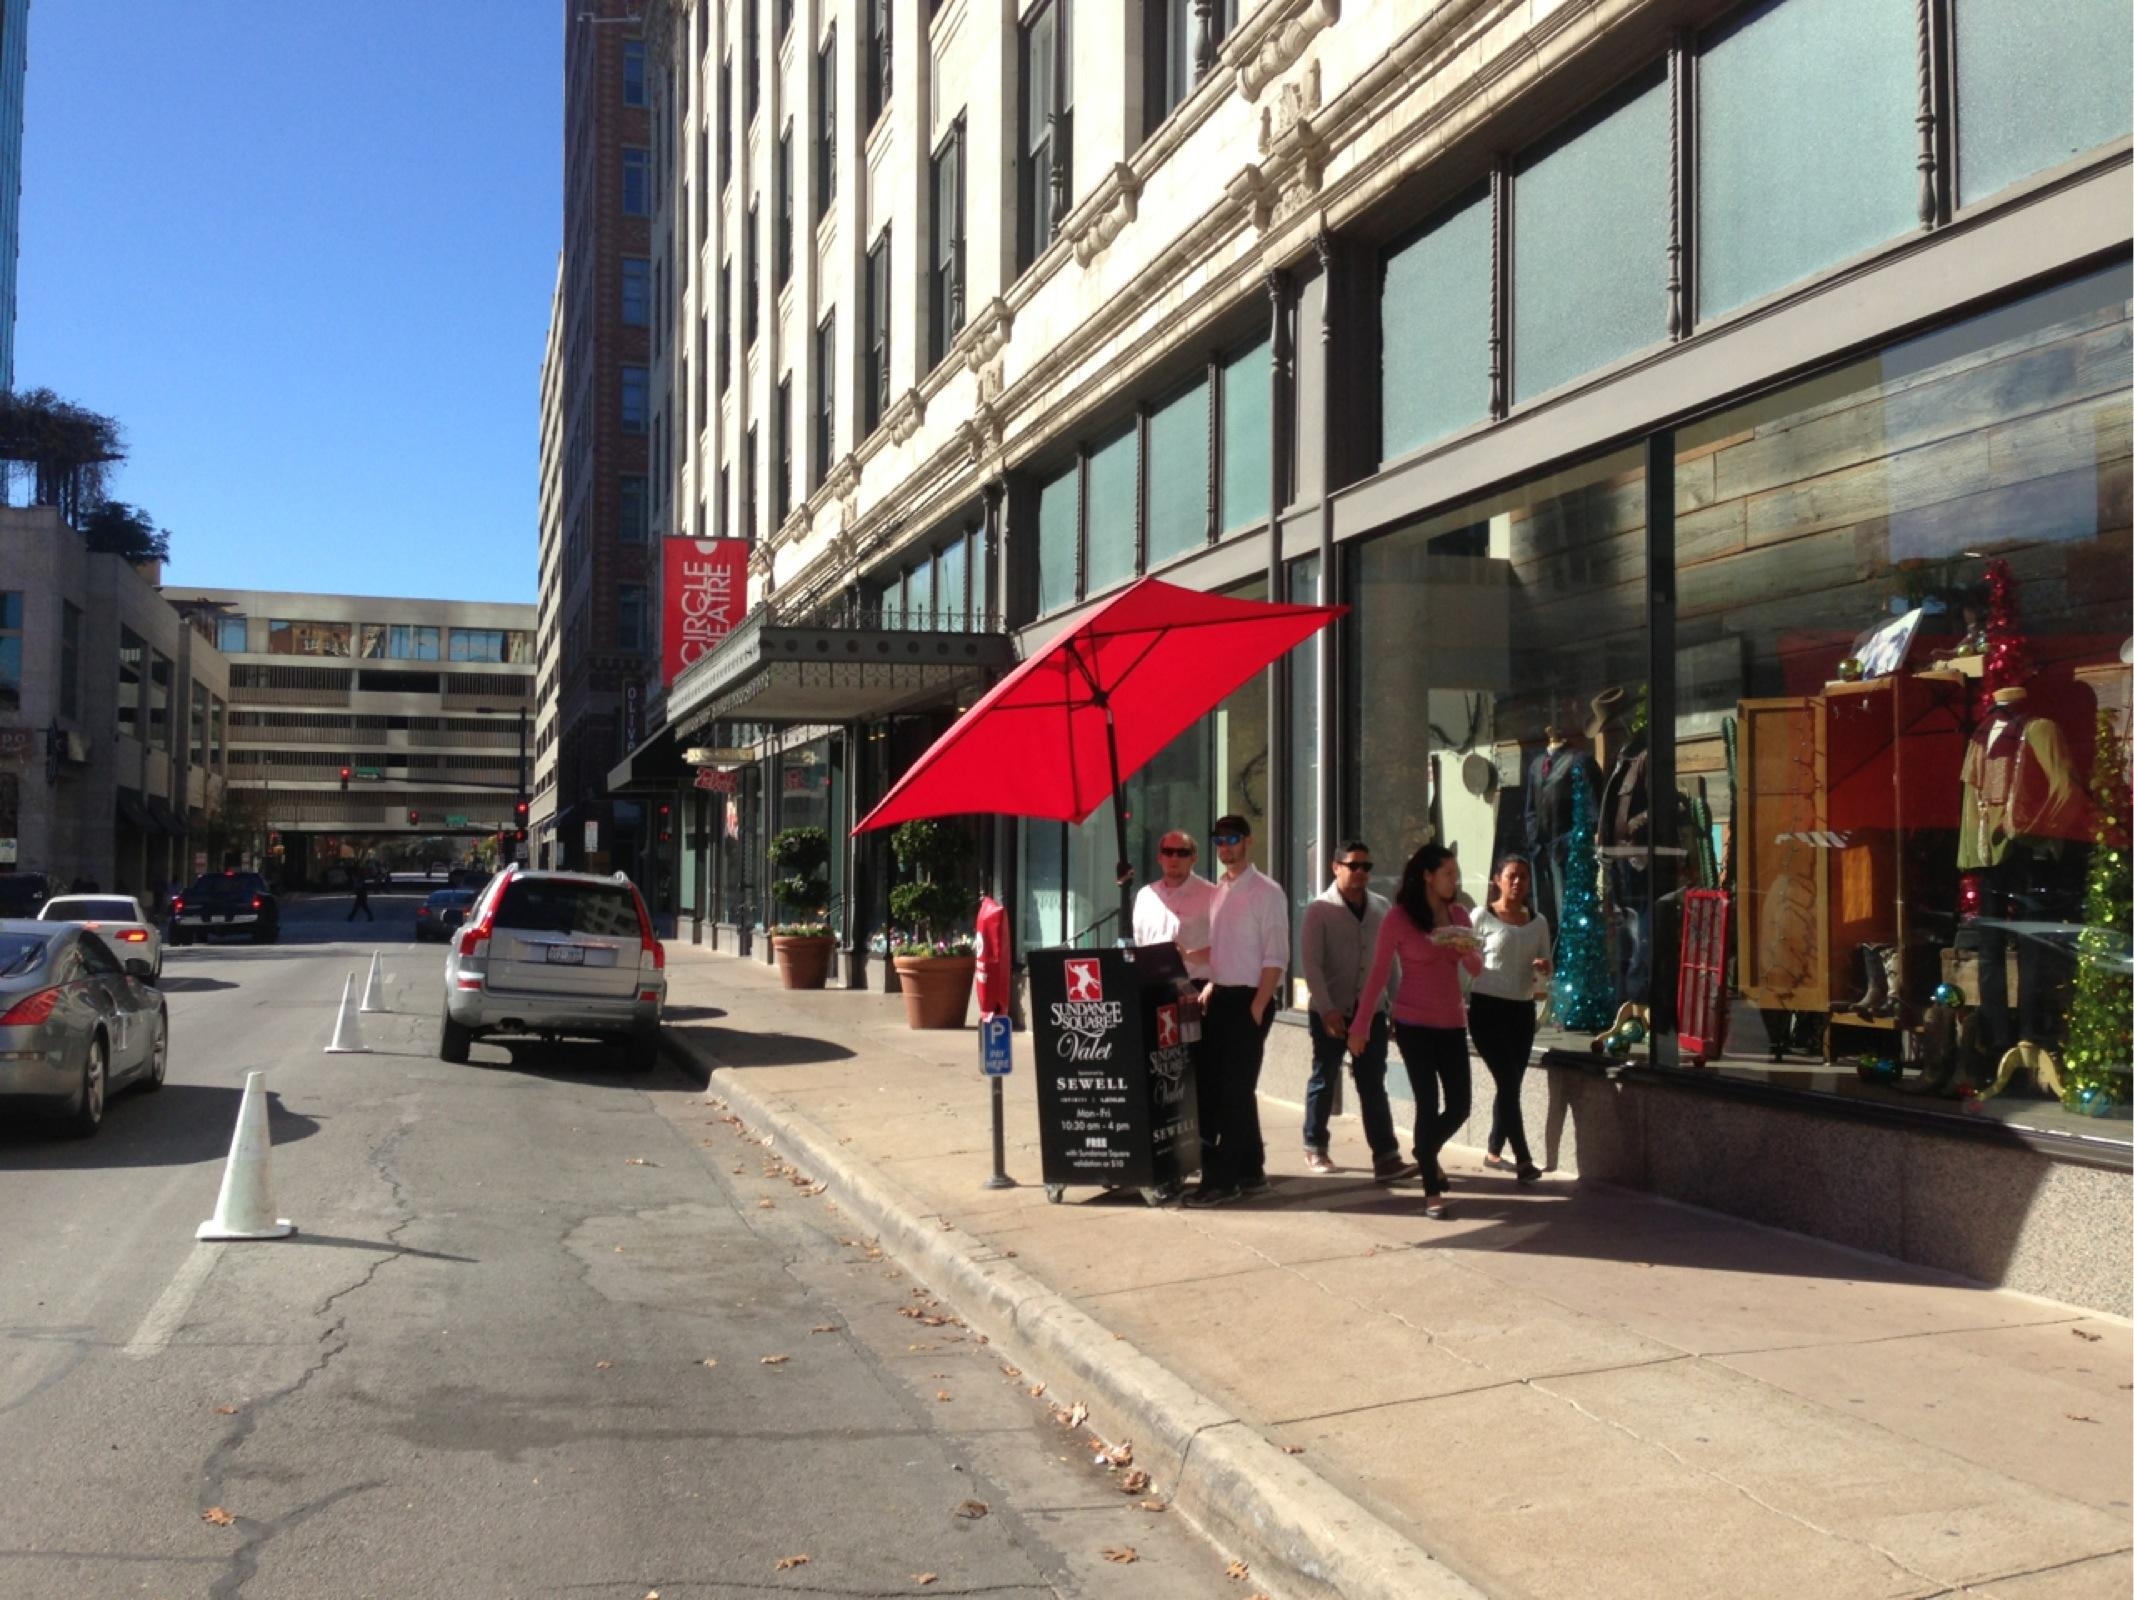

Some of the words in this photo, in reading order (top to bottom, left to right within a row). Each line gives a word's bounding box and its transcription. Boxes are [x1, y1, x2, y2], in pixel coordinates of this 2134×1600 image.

[681, 561, 709, 667] CIRCLE
[706, 563, 731, 650] EATRE
[1051, 1001, 1123, 1026] SUNDANCE
[1061, 1015, 1116, 1034] SQUARE
[1057, 1031, 1113, 1062] Valet
[1056, 1077, 1128, 1091] SEWELL
